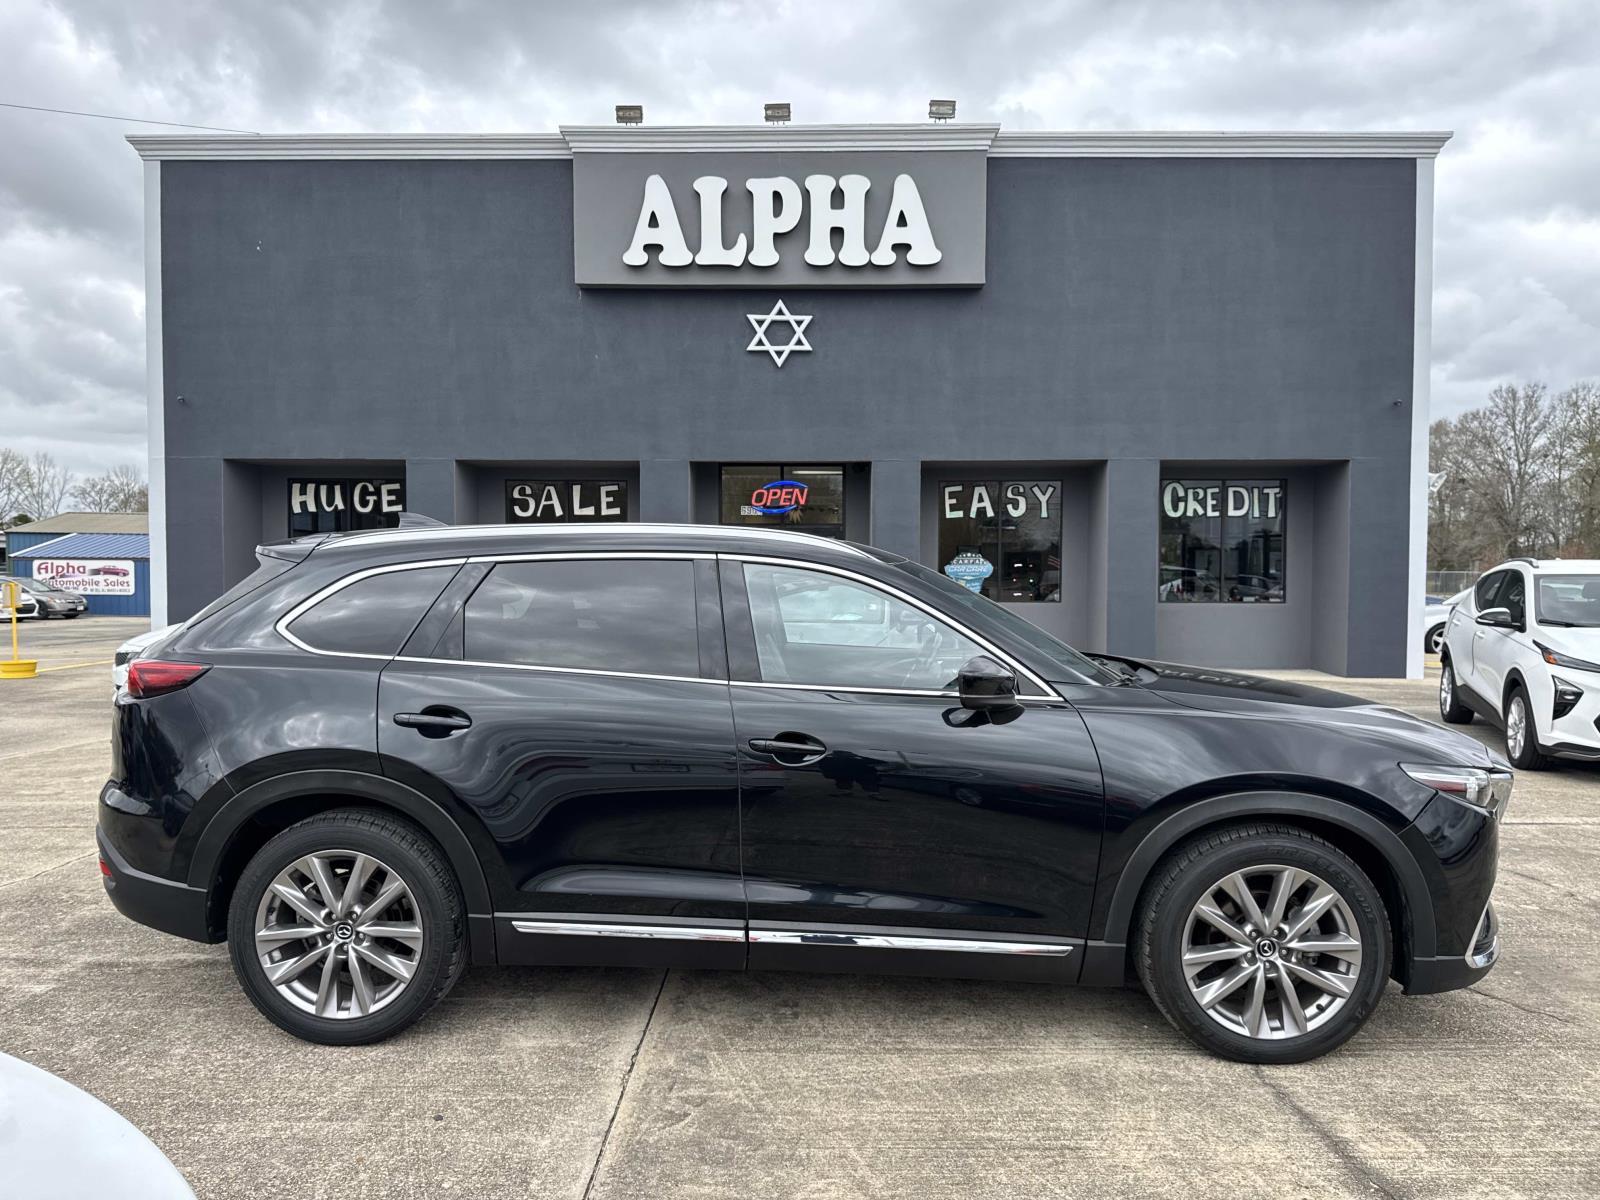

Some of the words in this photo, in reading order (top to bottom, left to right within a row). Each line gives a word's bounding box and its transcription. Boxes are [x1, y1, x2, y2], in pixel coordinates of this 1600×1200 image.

[622, 173, 942, 267] ALPHA
[291, 481, 403, 513] HUGE
[512, 484, 622, 517] SALE
[751, 488, 808, 506] OPEN
[943, 484, 1056, 518] EASY
[1162, 481, 1283, 518] CREDIT
[37, 562, 86, 576] Alpha
[104, 578, 130, 587] Sales
